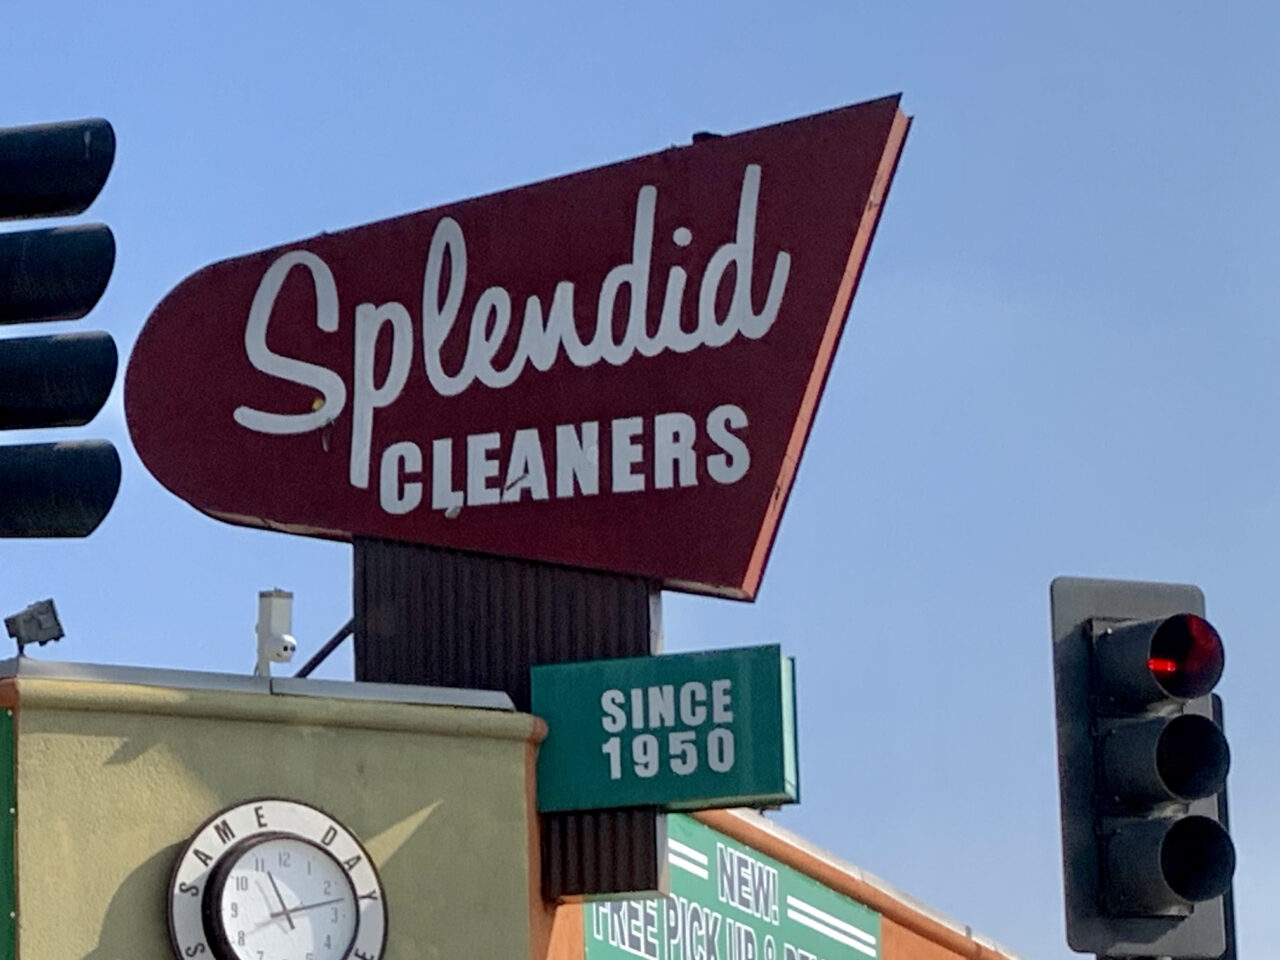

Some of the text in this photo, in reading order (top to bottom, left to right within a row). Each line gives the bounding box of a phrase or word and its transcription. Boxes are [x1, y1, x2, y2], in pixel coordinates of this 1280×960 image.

[233, 163, 791, 488] Splendid
[380, 404, 751, 516] CLEANERS
[601, 679, 734, 734] SINCE
[602, 727, 736, 781] 1950
[179, 806, 379, 902] SAME DAY
[278, 851, 291, 868] 12
[254, 858, 266, 873] 11
[307, 861, 312, 876] 1
[235, 876, 248, 892] 10
[323, 880, 332, 896] 2
[716, 842, 780, 926] NEW!
[231, 903, 239, 919] 9
[331, 907, 338, 923] 3
[237, 930, 245, 947] 8
[324, 934, 332, 950] 4
